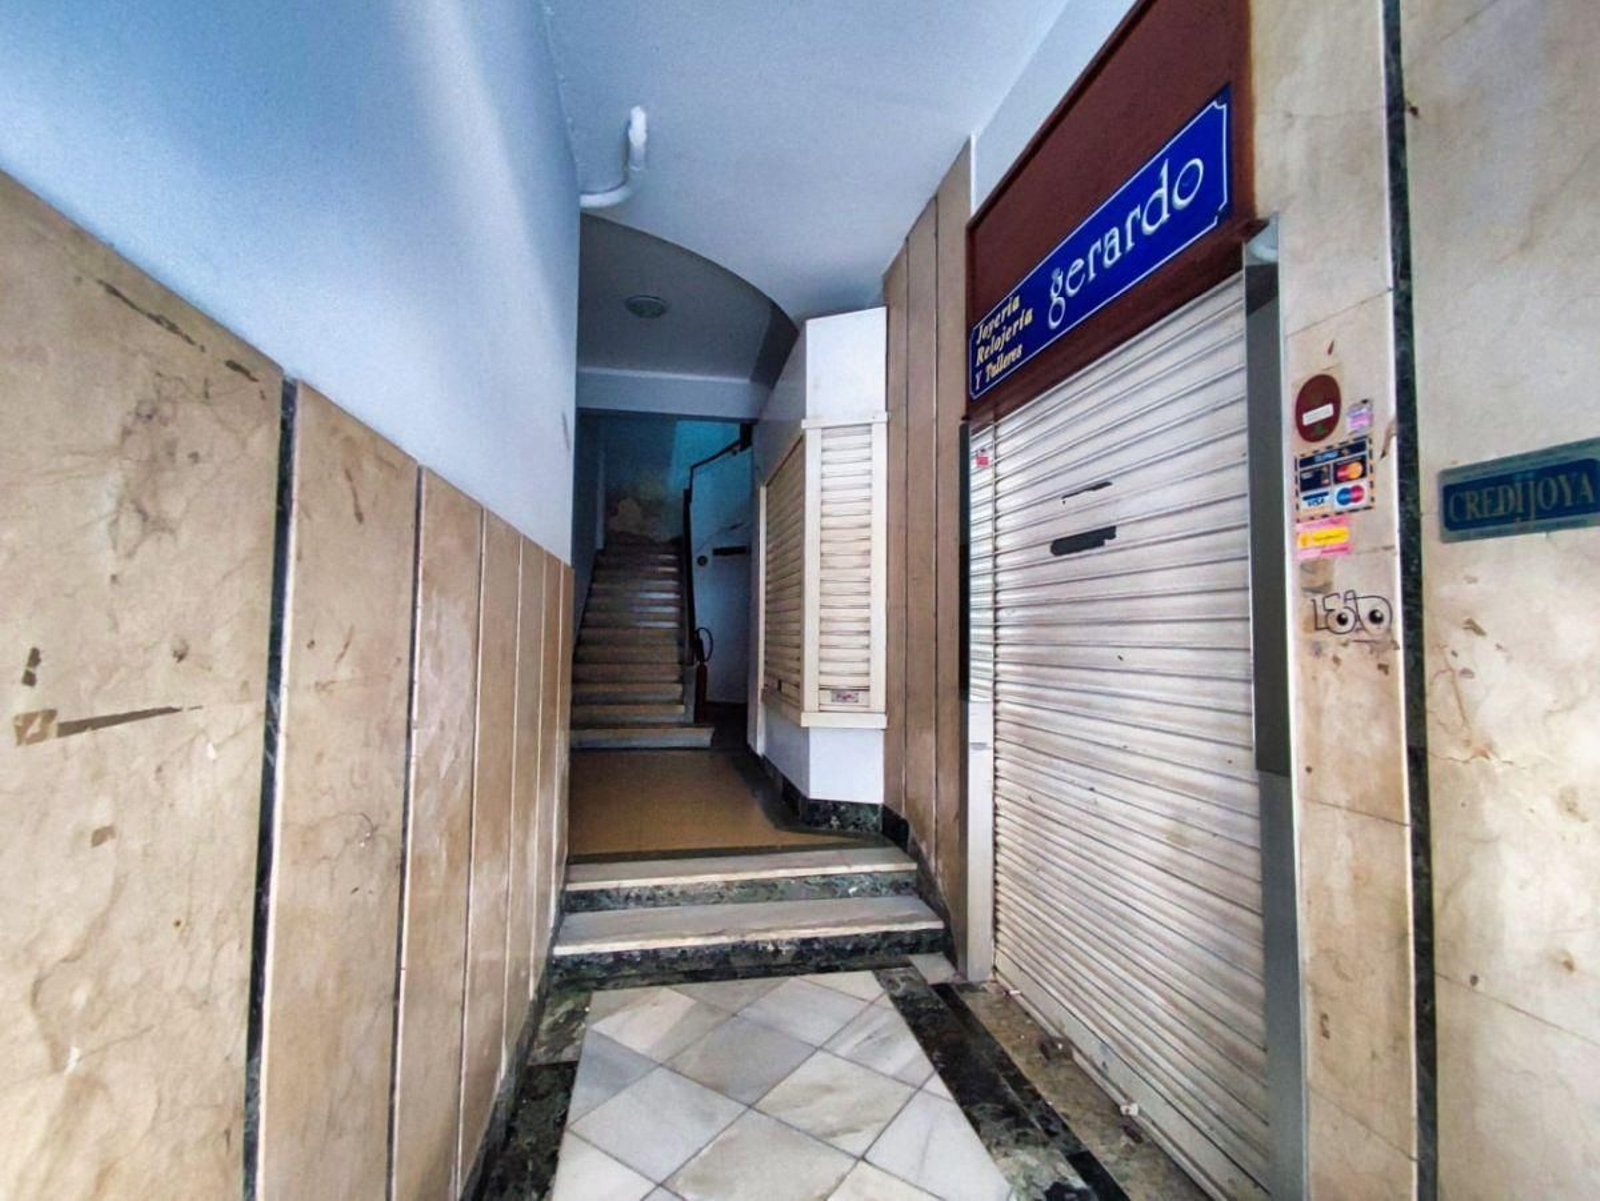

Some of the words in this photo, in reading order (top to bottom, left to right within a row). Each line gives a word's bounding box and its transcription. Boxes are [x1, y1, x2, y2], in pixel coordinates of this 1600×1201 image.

[1048, 157, 1205, 330] gerardo
[975, 370, 983, 390] Y
[985, 344, 1023, 383] Talleres
[1449, 472, 1595, 529] CREDIJOYA
